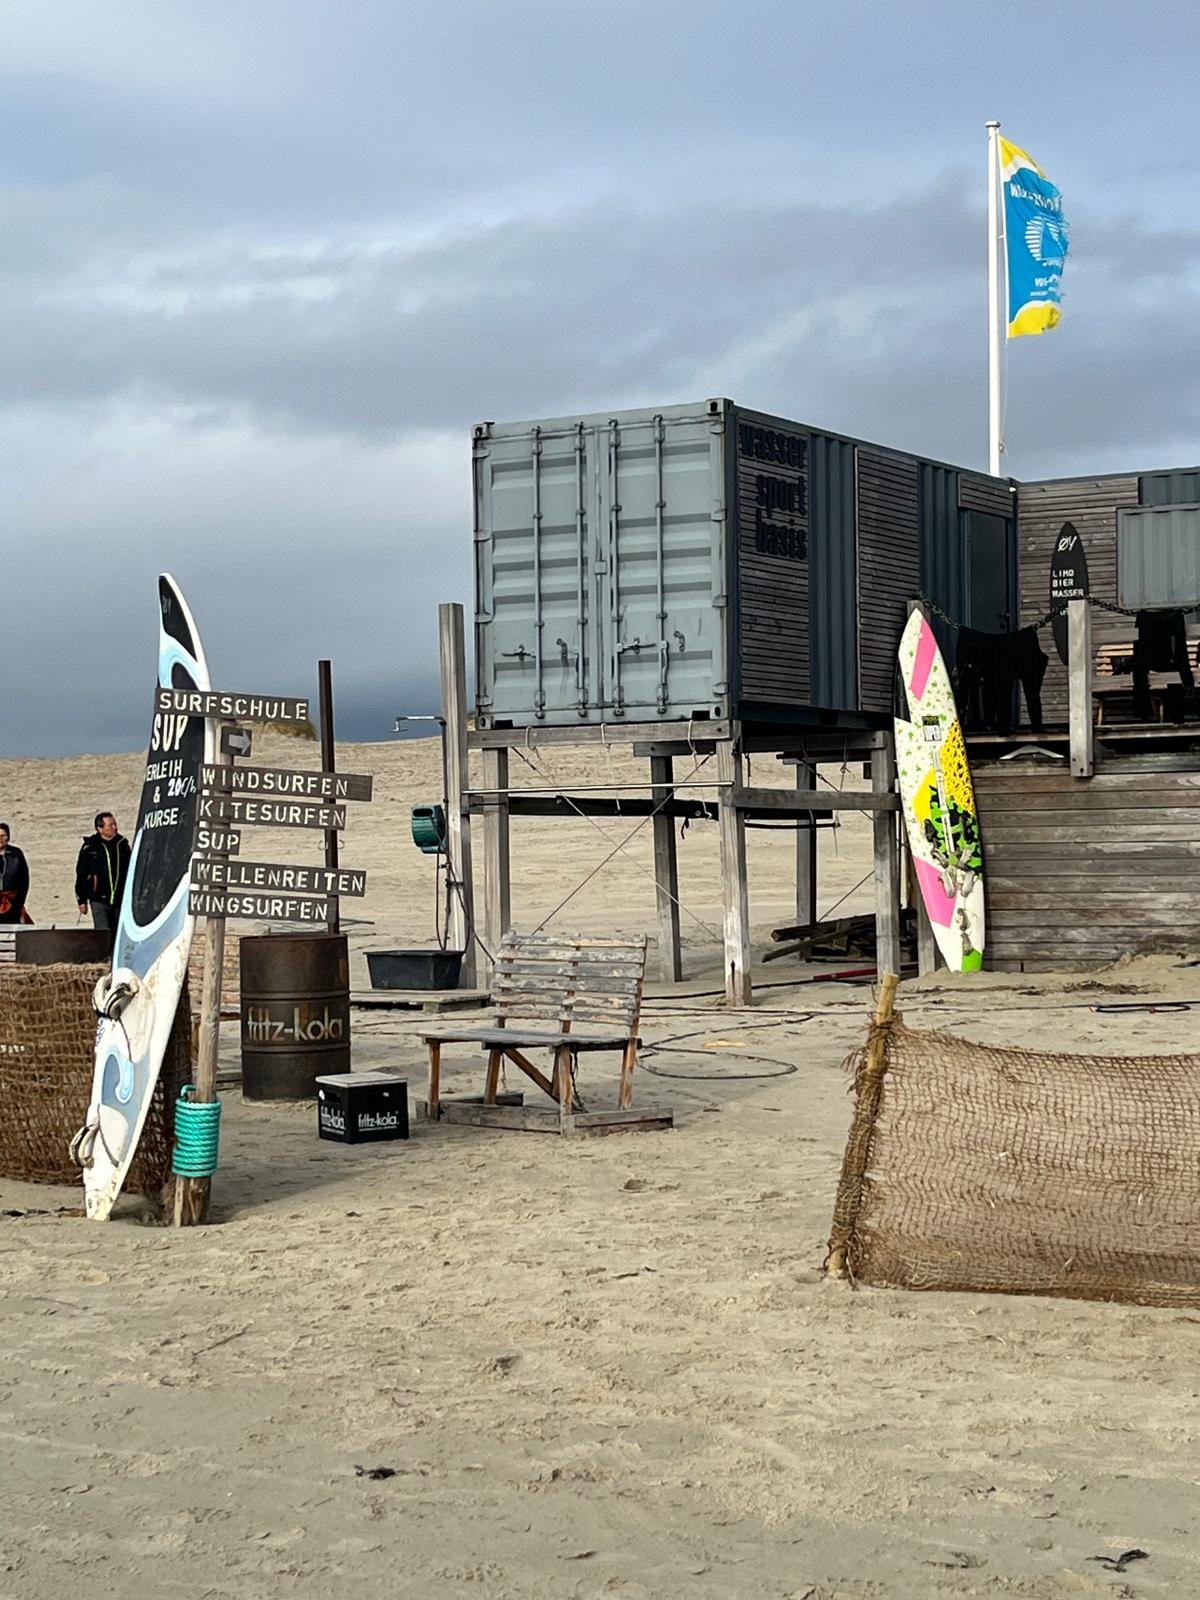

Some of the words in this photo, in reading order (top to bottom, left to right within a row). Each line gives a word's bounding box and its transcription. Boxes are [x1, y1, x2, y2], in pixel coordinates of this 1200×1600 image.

[738, 424, 808, 469] wasser
[756, 474, 807, 518] sport
[756, 508, 807, 560] basis
[1051, 588, 1084, 598] WASSER
[1052, 579, 1074, 588] BIER
[159, 692, 307, 720] SURFSCHULE
[152, 713, 188, 752] SUP
[146, 759, 183, 782] ERLEIH
[202, 767, 348, 796] WINDSURFEN
[153, 786, 161, 803] &
[143, 807, 179, 830] KURSE
[200, 799, 345, 827] KITESURFEN
[197, 831, 239, 850] SUP
[197, 862, 364, 892] WELLENREITEN
[190, 893, 328, 921] WINGSURFEN
[247, 1006, 343, 1041] fritz-kola
